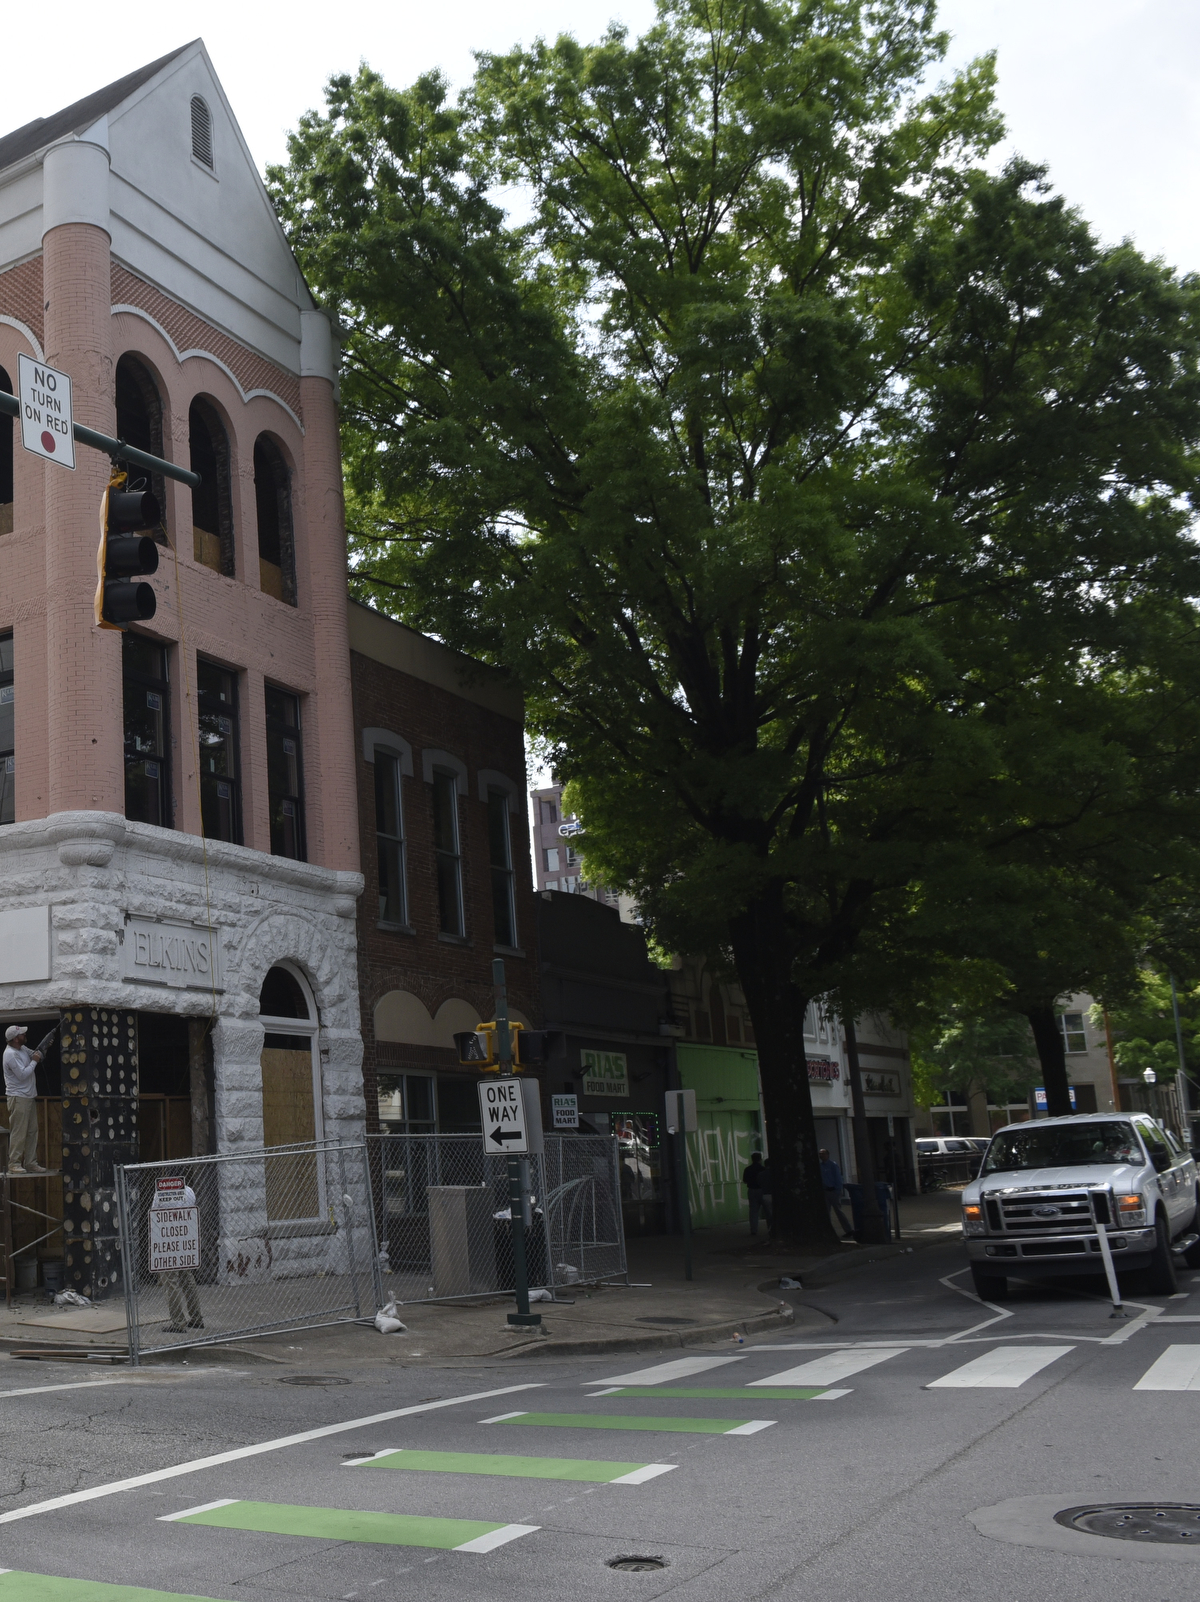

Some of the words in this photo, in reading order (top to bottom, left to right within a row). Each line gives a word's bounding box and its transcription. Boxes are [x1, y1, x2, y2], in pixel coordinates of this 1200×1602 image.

[35, 367, 57, 392] NO
[31, 388, 61, 414] TURN
[25, 404, 41, 424] ON
[46, 414, 68, 435] RED
[134, 931, 208, 974] ELKINS
[585, 1053, 625, 1080] RIA'S
[487, 1085, 516, 1103] ONE
[586, 1081, 605, 1093] FOOD
[606, 1082, 626, 1094] MART
[554, 1098, 576, 1106] RIA'S
[488, 1105, 518, 1123] WAY
[159, 1180, 182, 1188] DANGER
[156, 1210, 192, 1223] SIDEWALK
[161, 1225, 188, 1238] CLOSED
[154, 1241, 180, 1253] PLEASE
[182, 1240, 196, 1251] USE
[154, 1256, 177, 1268] OTHER
[179, 1255, 196, 1266] SIDE
